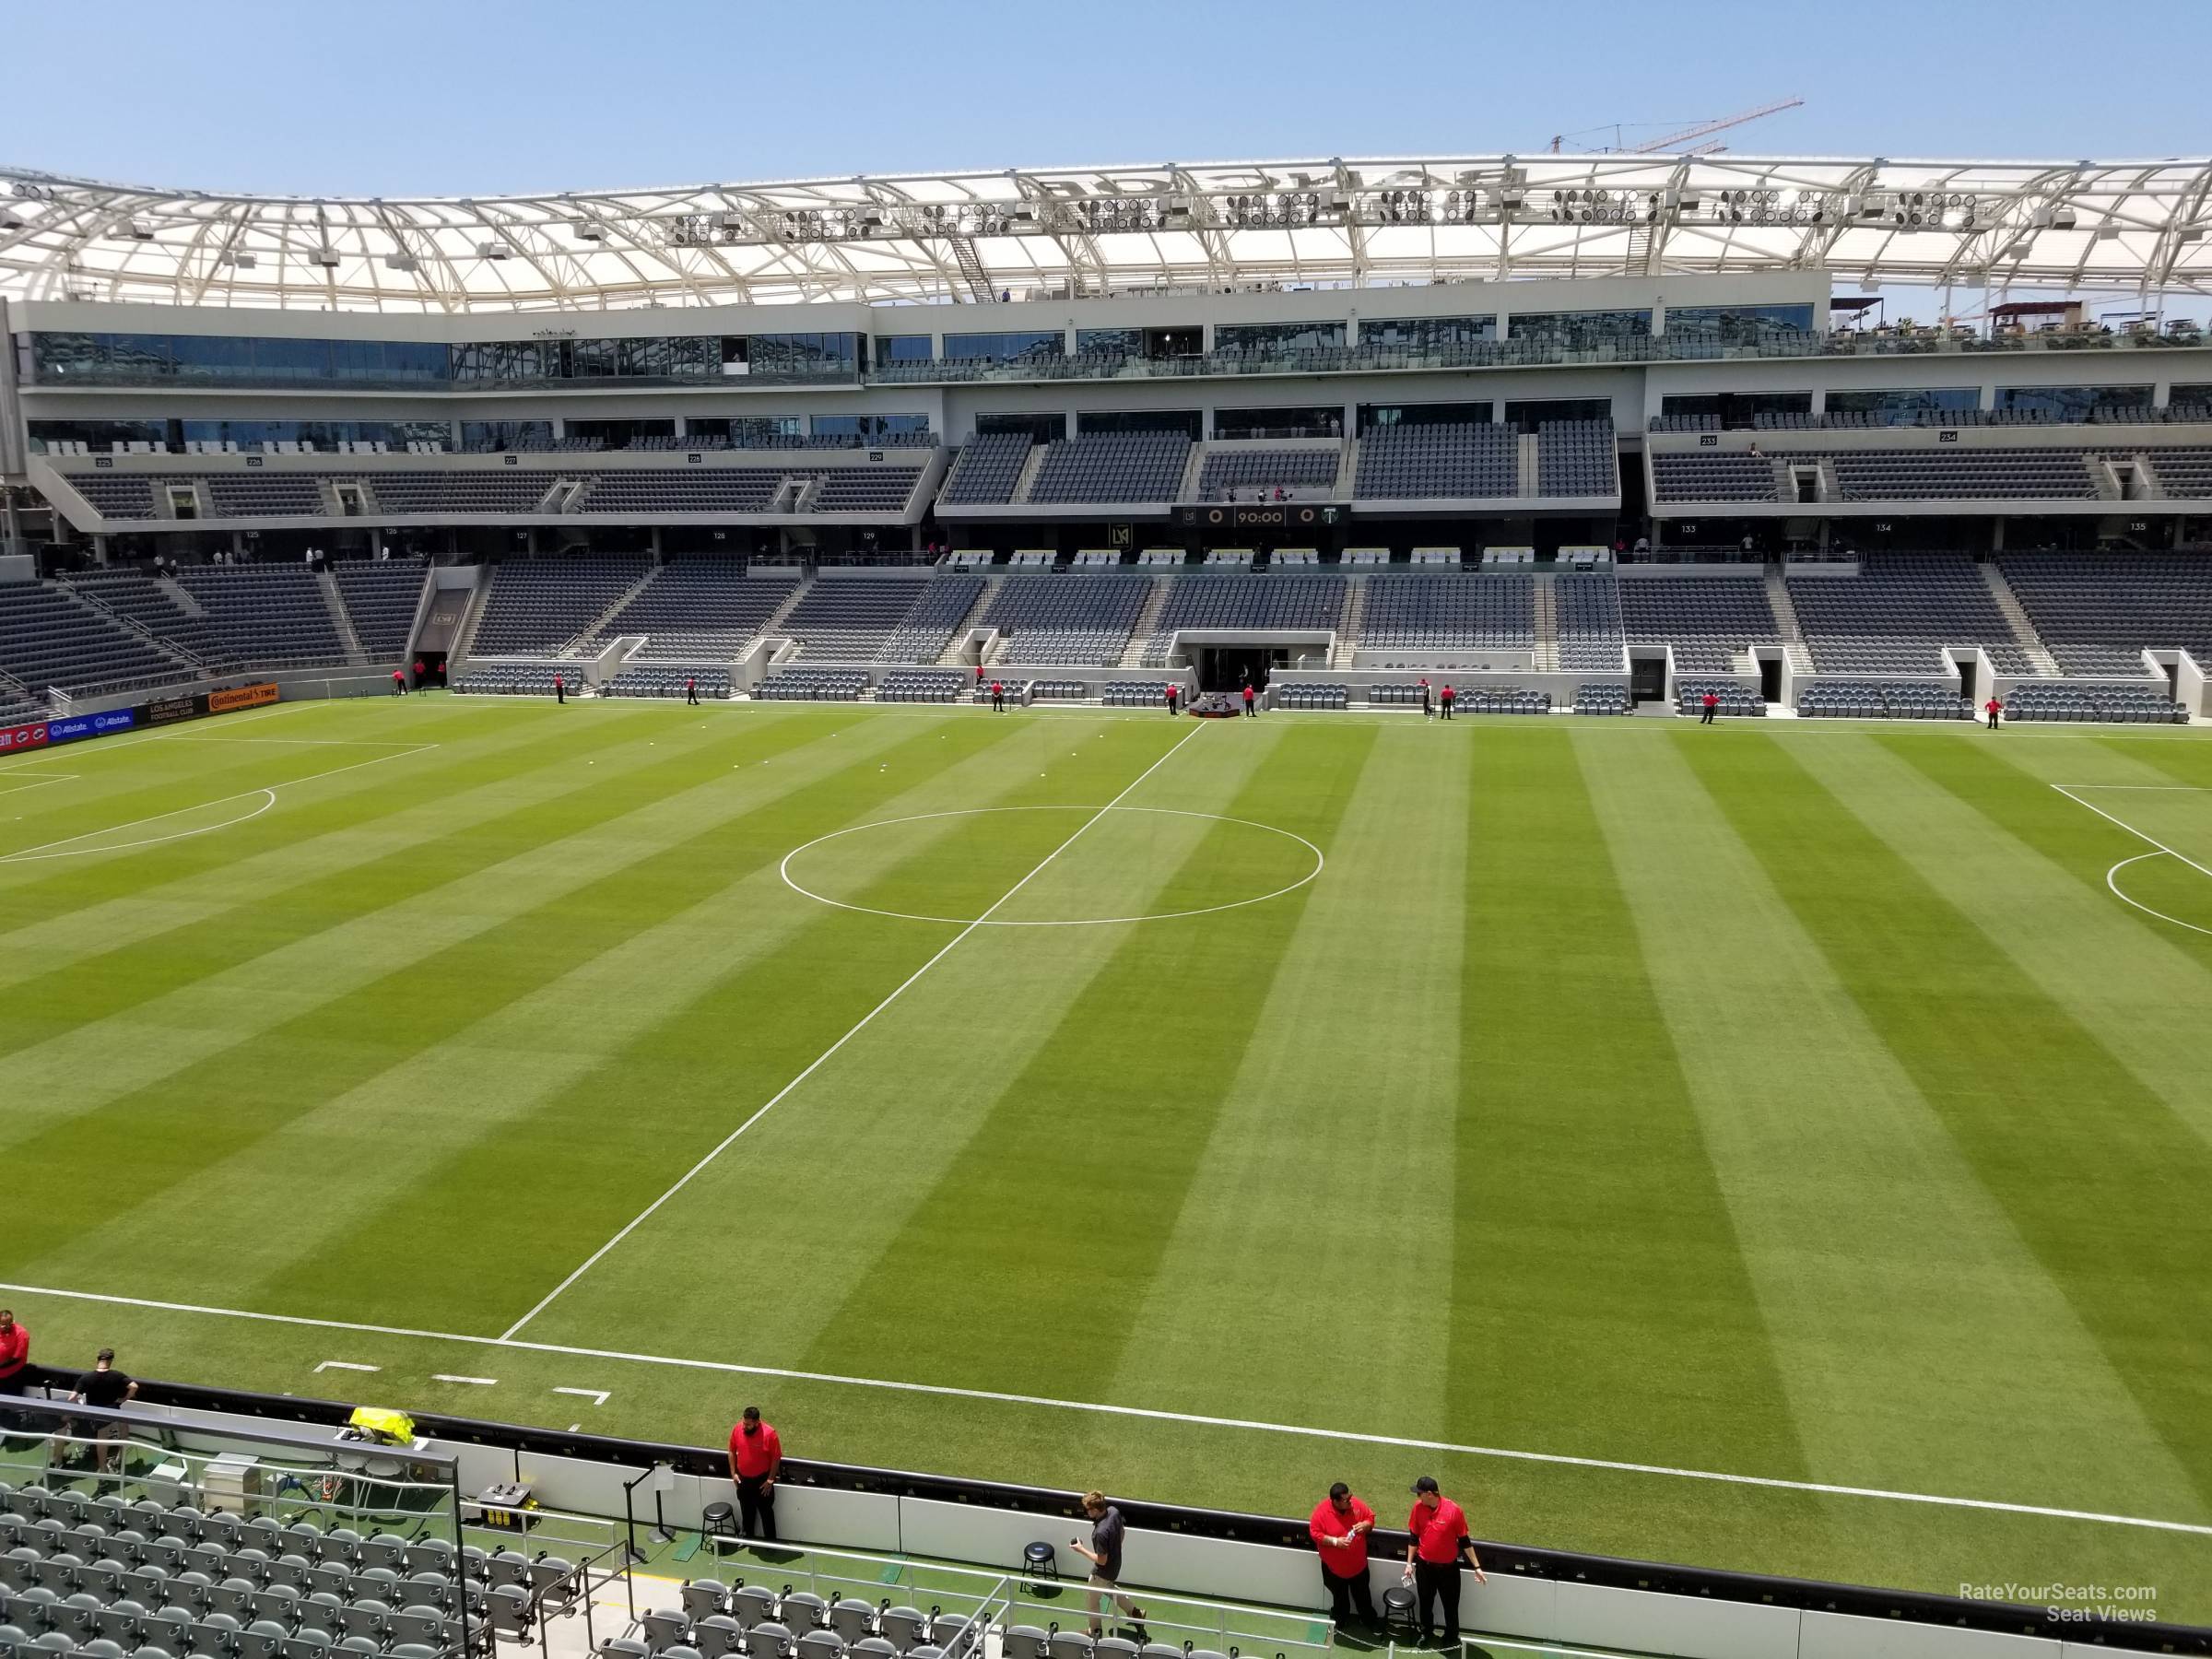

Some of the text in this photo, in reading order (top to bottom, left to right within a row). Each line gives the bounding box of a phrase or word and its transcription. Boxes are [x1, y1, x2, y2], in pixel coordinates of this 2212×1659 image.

[1701, 437, 1716, 445] 233
[1940, 433, 1957, 441] 234
[1238, 512, 1282, 523] 90:00
[1681, 525, 1696, 534] 133
[1876, 524, 1891, 532] 134
[2130, 523, 2147, 531] 135
[210, 689, 253, 709] Continental
[150, 700, 194, 713] LOS ANGELES
